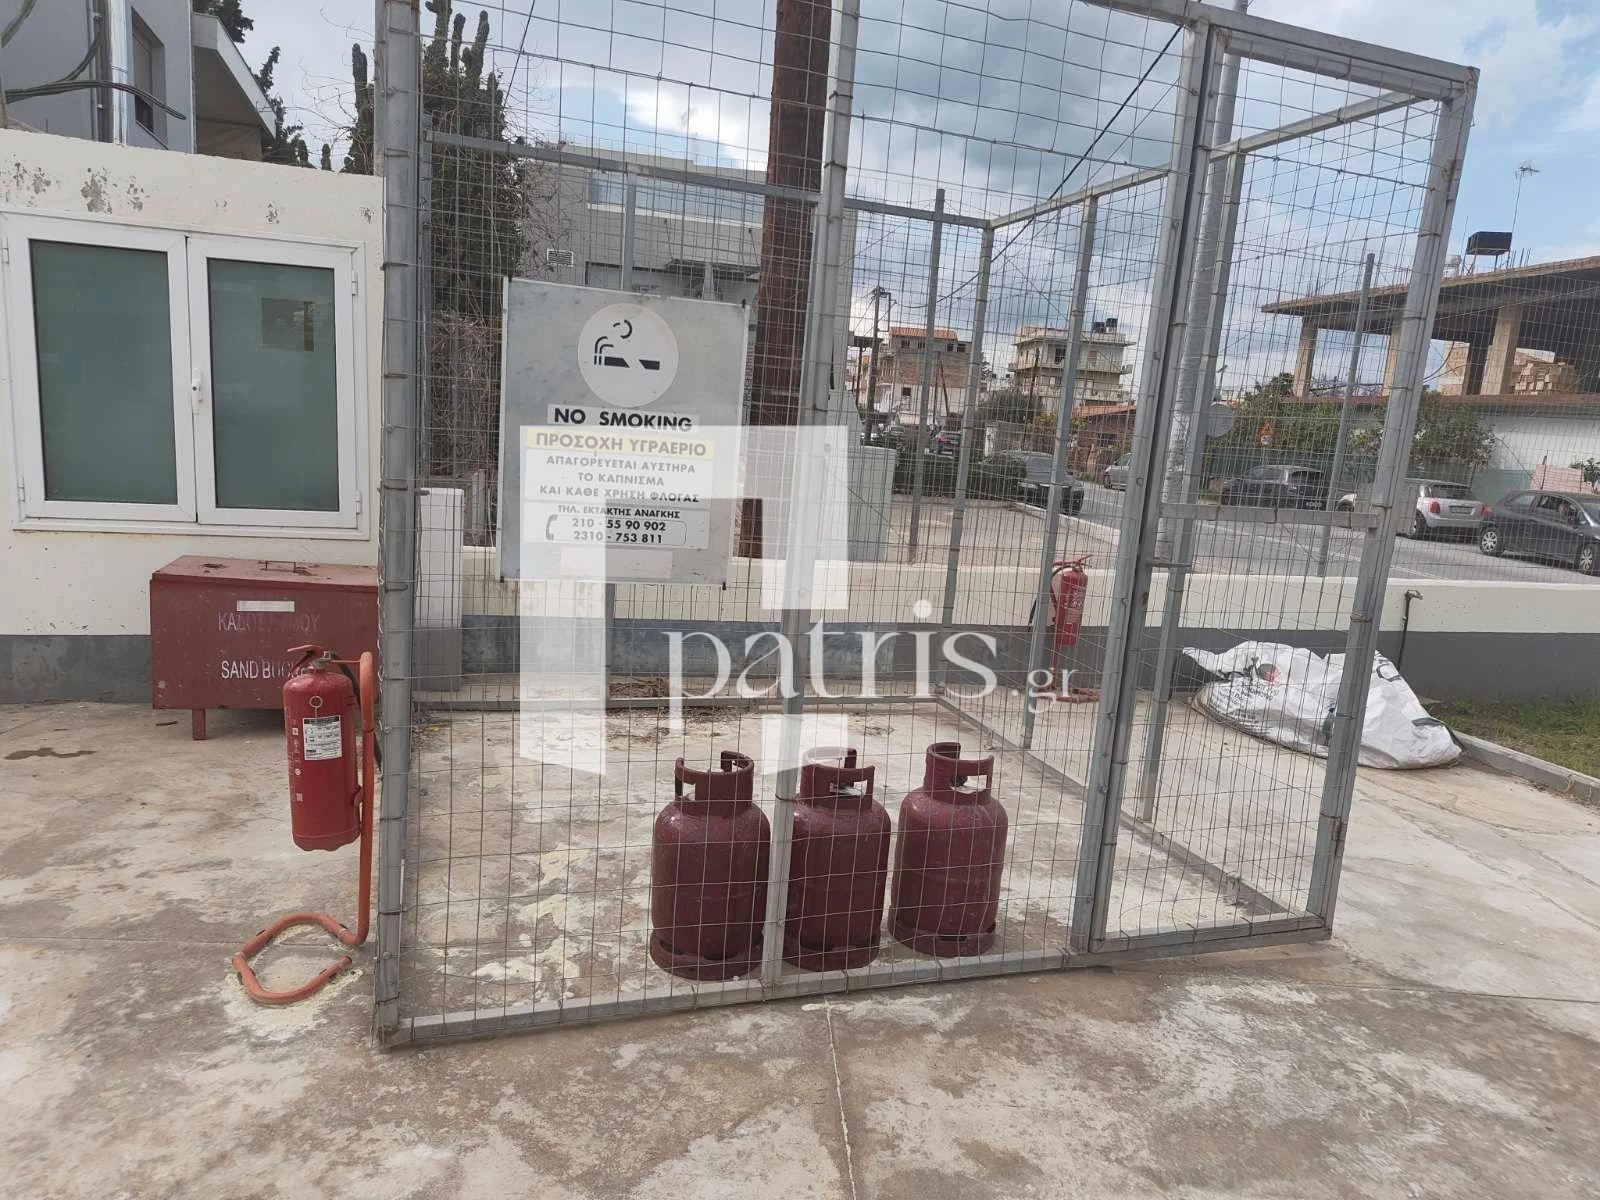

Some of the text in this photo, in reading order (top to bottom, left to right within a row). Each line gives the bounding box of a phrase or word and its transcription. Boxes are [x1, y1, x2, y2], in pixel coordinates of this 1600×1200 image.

[554, 407, 693, 432] NO SMOKING
[535, 432, 707, 457] ΠΡΟΣΟΧΗ ΥΓΡΑΕΡΙΟ
[546, 455, 696, 474] ΑΠΑΓΟΡΕΥΕΤΑΙ ΑΥΣΤΗΡΑ
[578, 472, 665, 486] ΤΟ ΚΑΠΝΙΣΜΑ
[539, 485, 700, 503] ΚΑΙ ΚΑΘΕ ΧΡΗΣΗ ΦΛΟΓΑΣ
[557, 504, 681, 519] ΤΗΛ. ΕΚΤΑΚΤΗΣ ΑΝΑΓΚΗΣ
[572, 517, 595, 528] 210
[606, 520, 622, 530] 55
[625, 521, 641, 531] 90
[643, 522, 667, 532] 902
[573, 530, 604, 542] 2310
[615, 533, 638, 543] 753
[641, 534, 663, 544] 811
[221, 660, 259, 679] SAND
